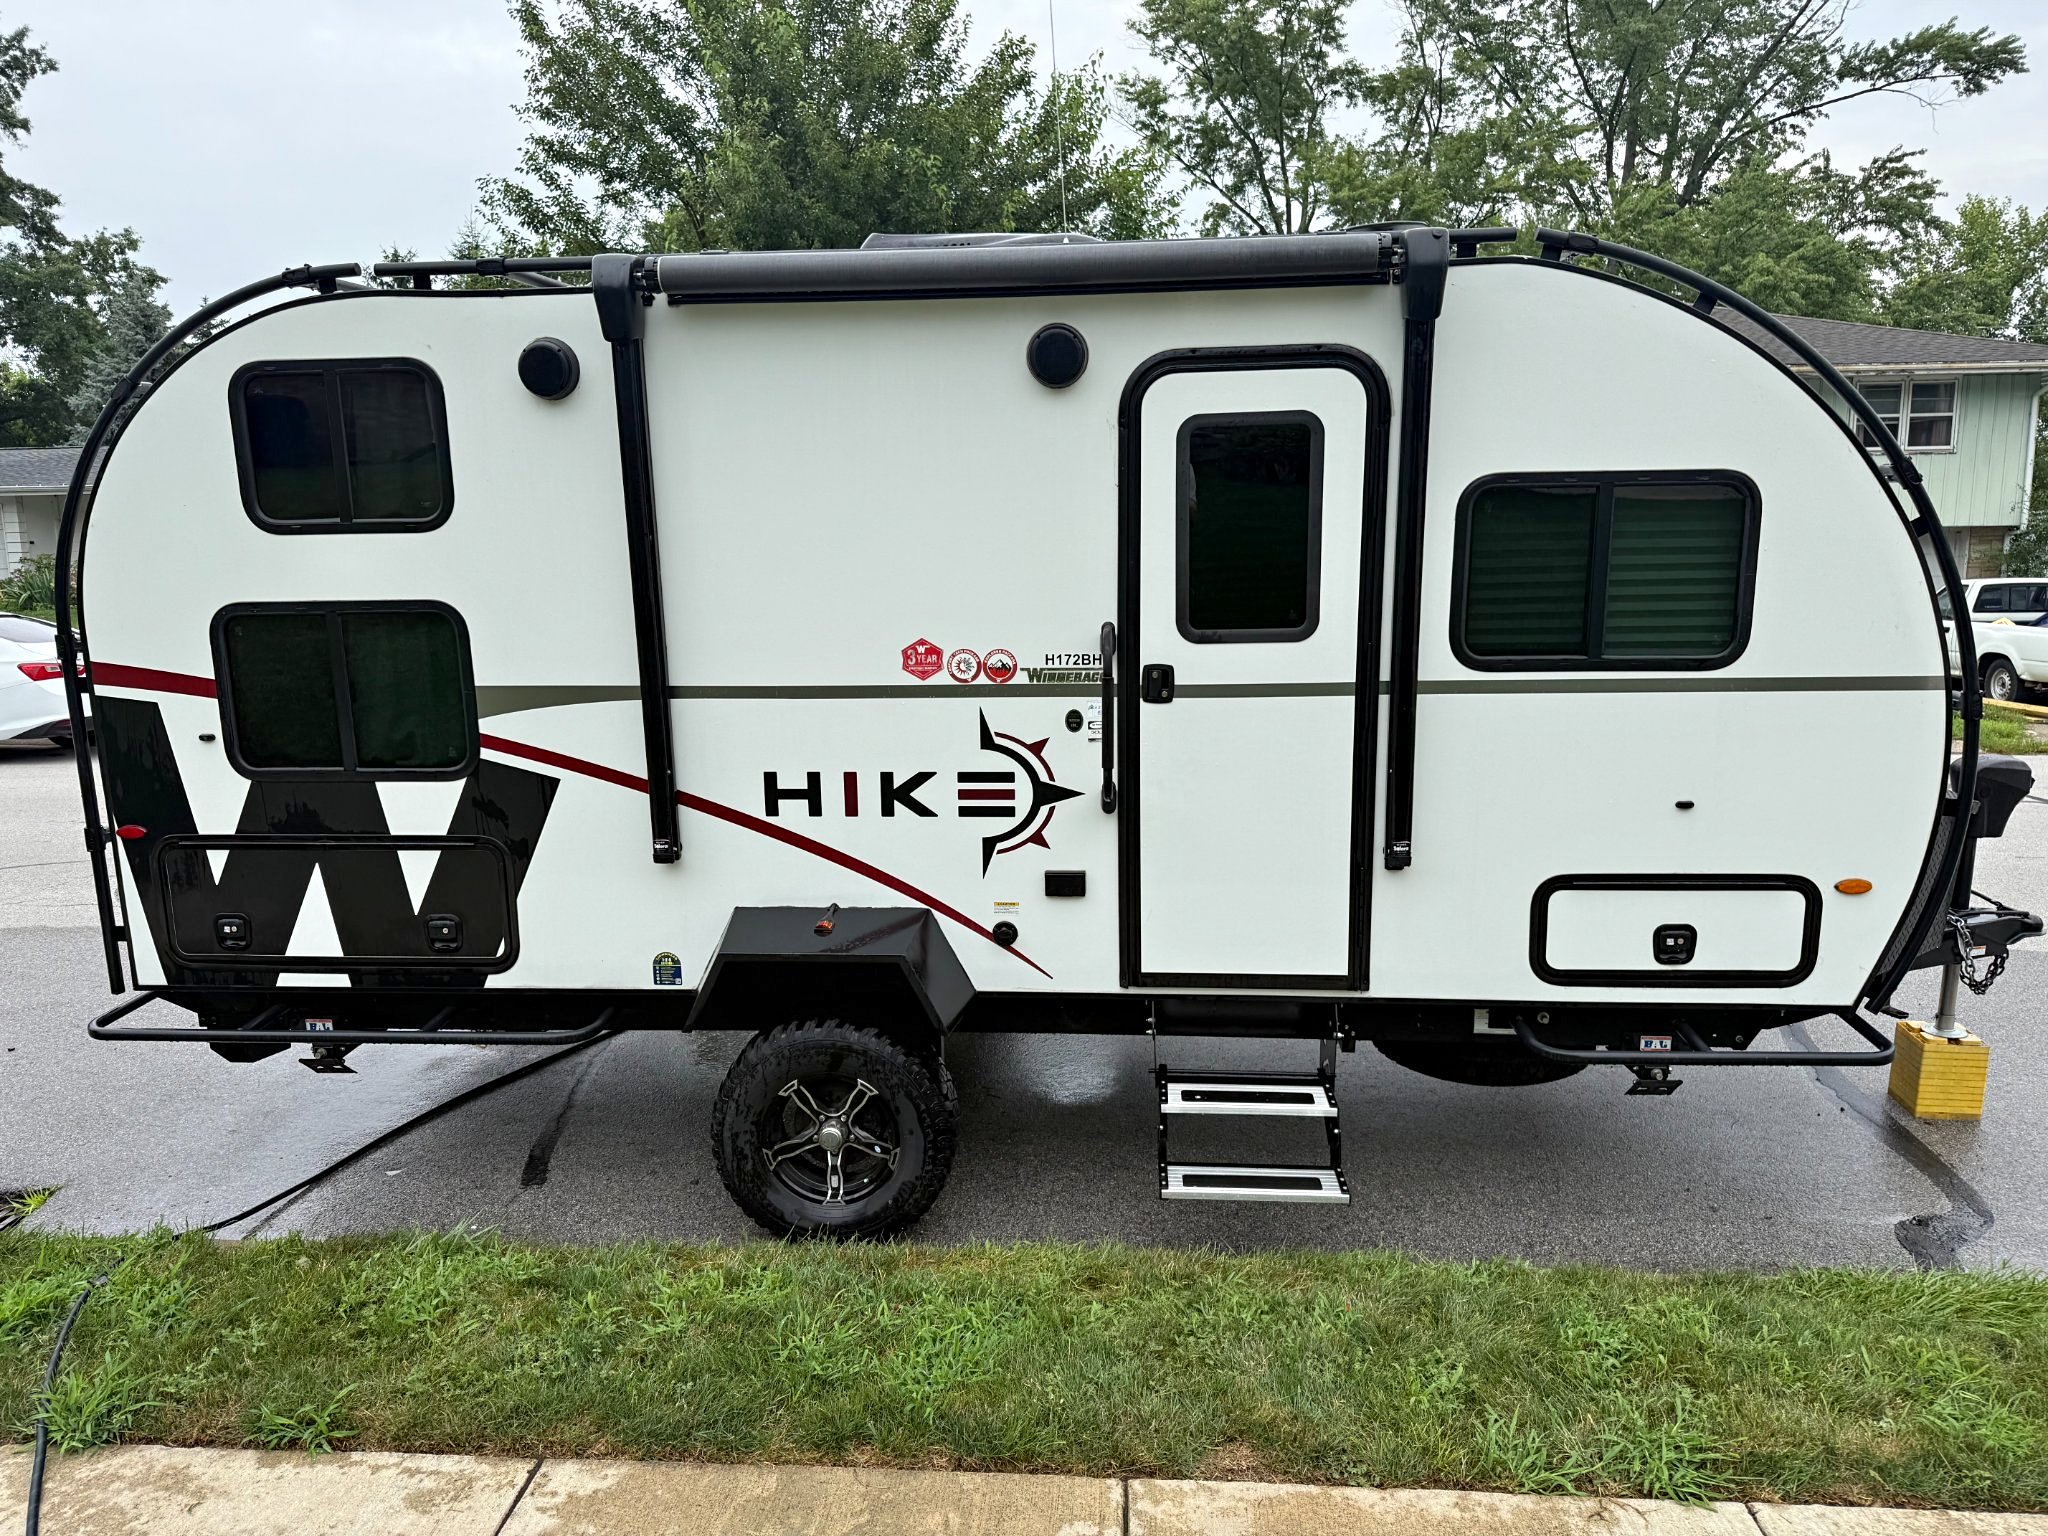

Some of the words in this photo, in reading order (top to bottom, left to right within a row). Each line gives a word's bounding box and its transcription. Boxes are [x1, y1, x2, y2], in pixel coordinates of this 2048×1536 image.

[907, 649, 916, 665] 3
[916, 654, 938, 664] YEAR
[1045, 653, 1102, 666] H172BH
[763, 771, 1016, 817] HIKE
